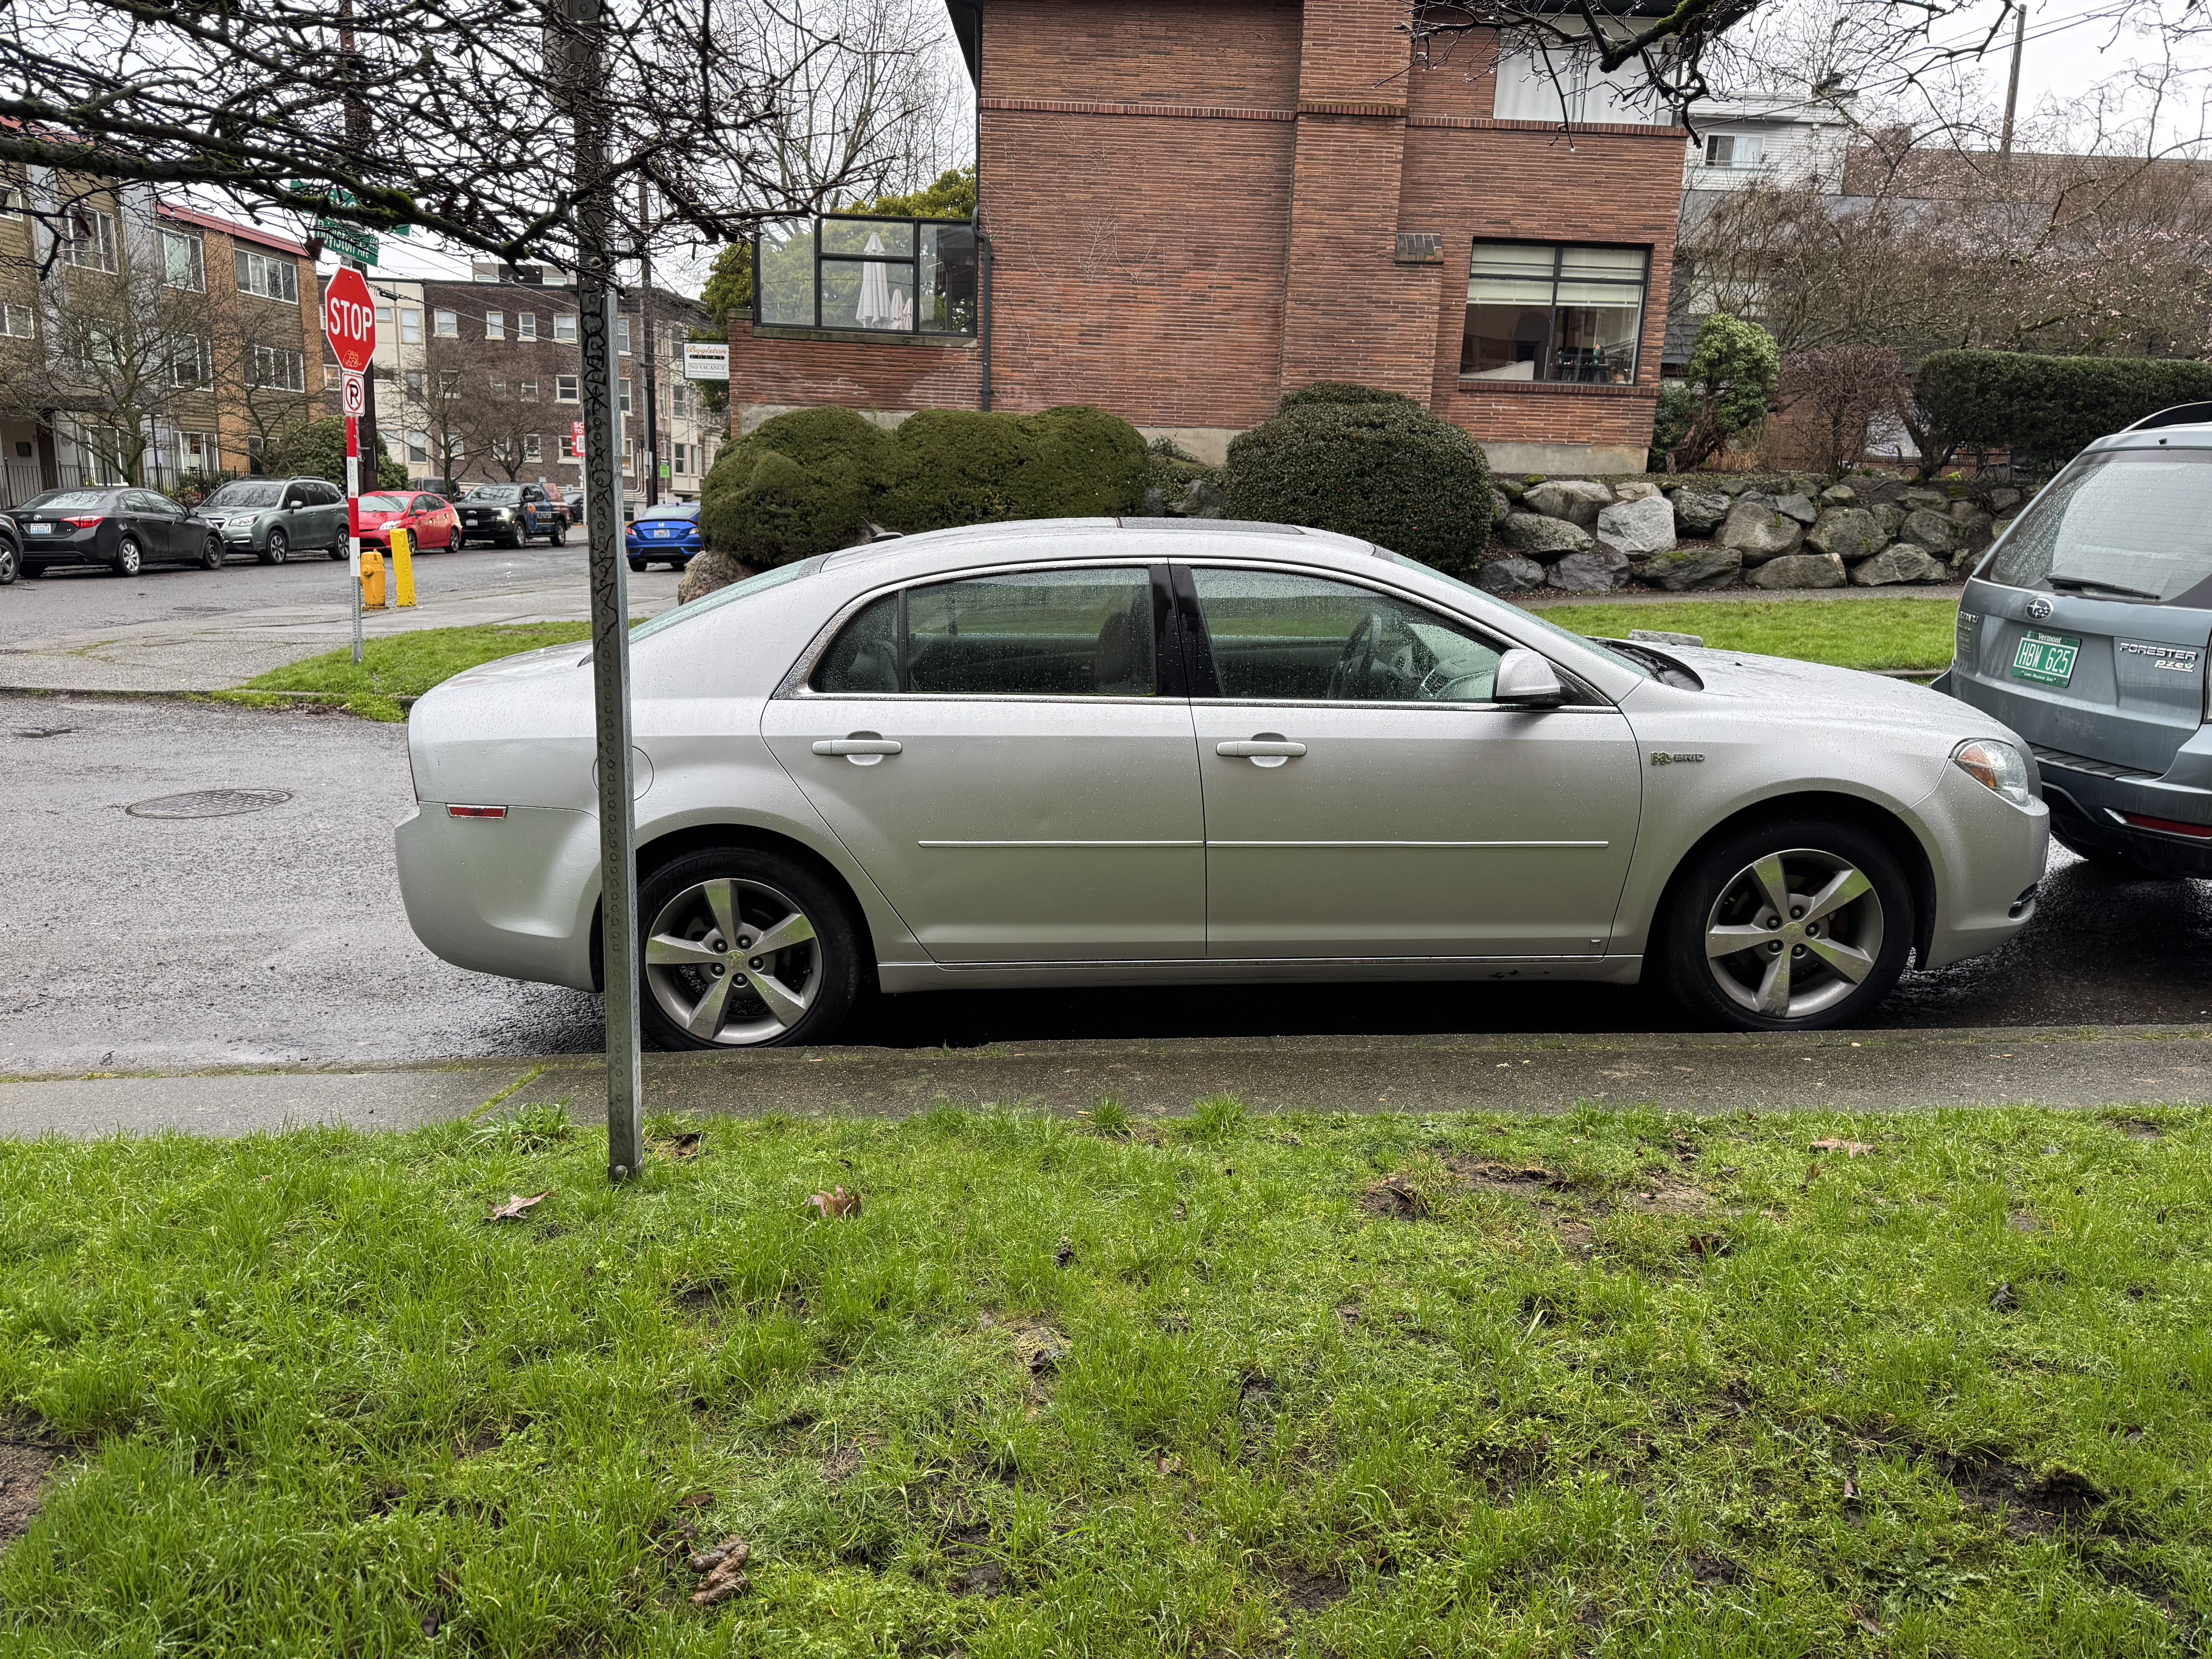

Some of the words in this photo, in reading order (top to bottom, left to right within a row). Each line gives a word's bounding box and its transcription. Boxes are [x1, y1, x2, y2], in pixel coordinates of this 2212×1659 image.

[330, 297, 373, 342] STOP
[686, 345, 726, 356] Boylston
[2038, 632, 2062, 644] Vermont
[2019, 642, 2044, 668] HBW
[2045, 647, 2071, 673] 625
[2119, 642, 2197, 661] FORESTER
